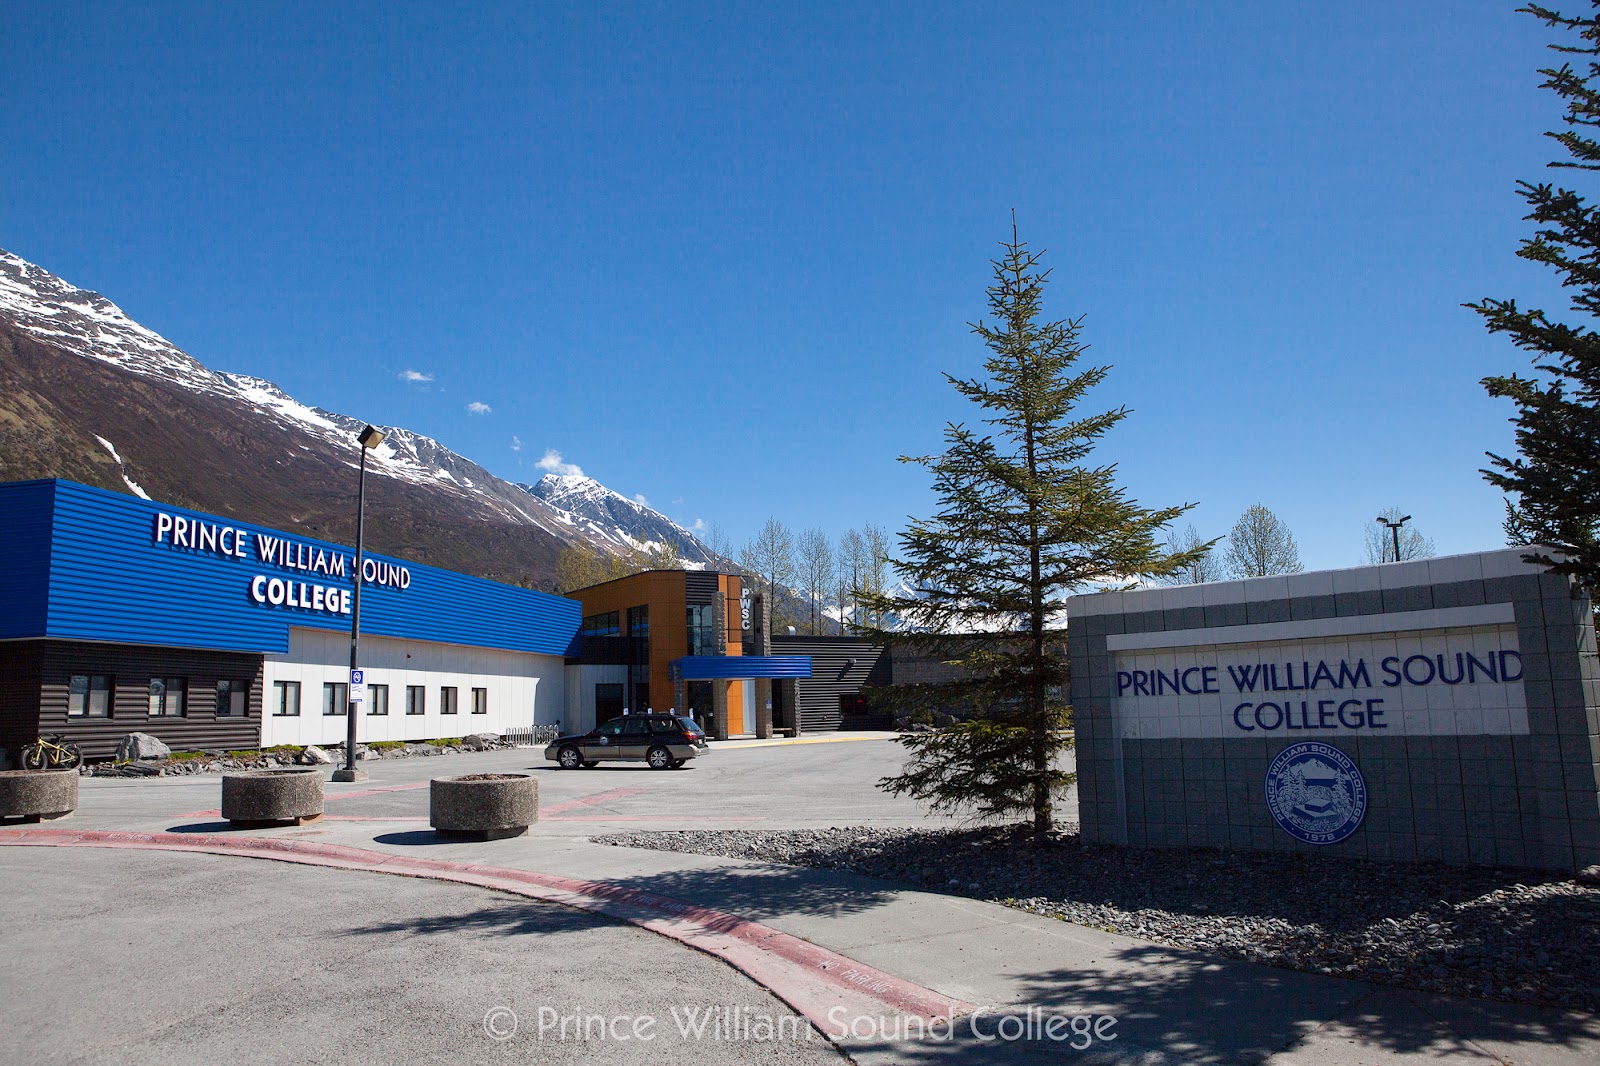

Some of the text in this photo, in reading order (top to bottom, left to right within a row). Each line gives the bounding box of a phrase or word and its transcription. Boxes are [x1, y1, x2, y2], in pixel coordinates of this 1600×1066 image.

[157, 512, 247, 557] PRINCE
[257, 533, 346, 577] WILLIAM
[251, 575, 351, 614] COLLEGE
[740, 587, 752, 630] PWSC
[1116, 650, 1524, 697] PRINCE WILLIAM SOUND
[1233, 698, 1387, 731] COLLEGE
[1268, 745, 1363, 824] PRINCE WILLIAM SOUND COLLEGE
[1304, 833, 1335, 841] 1978
